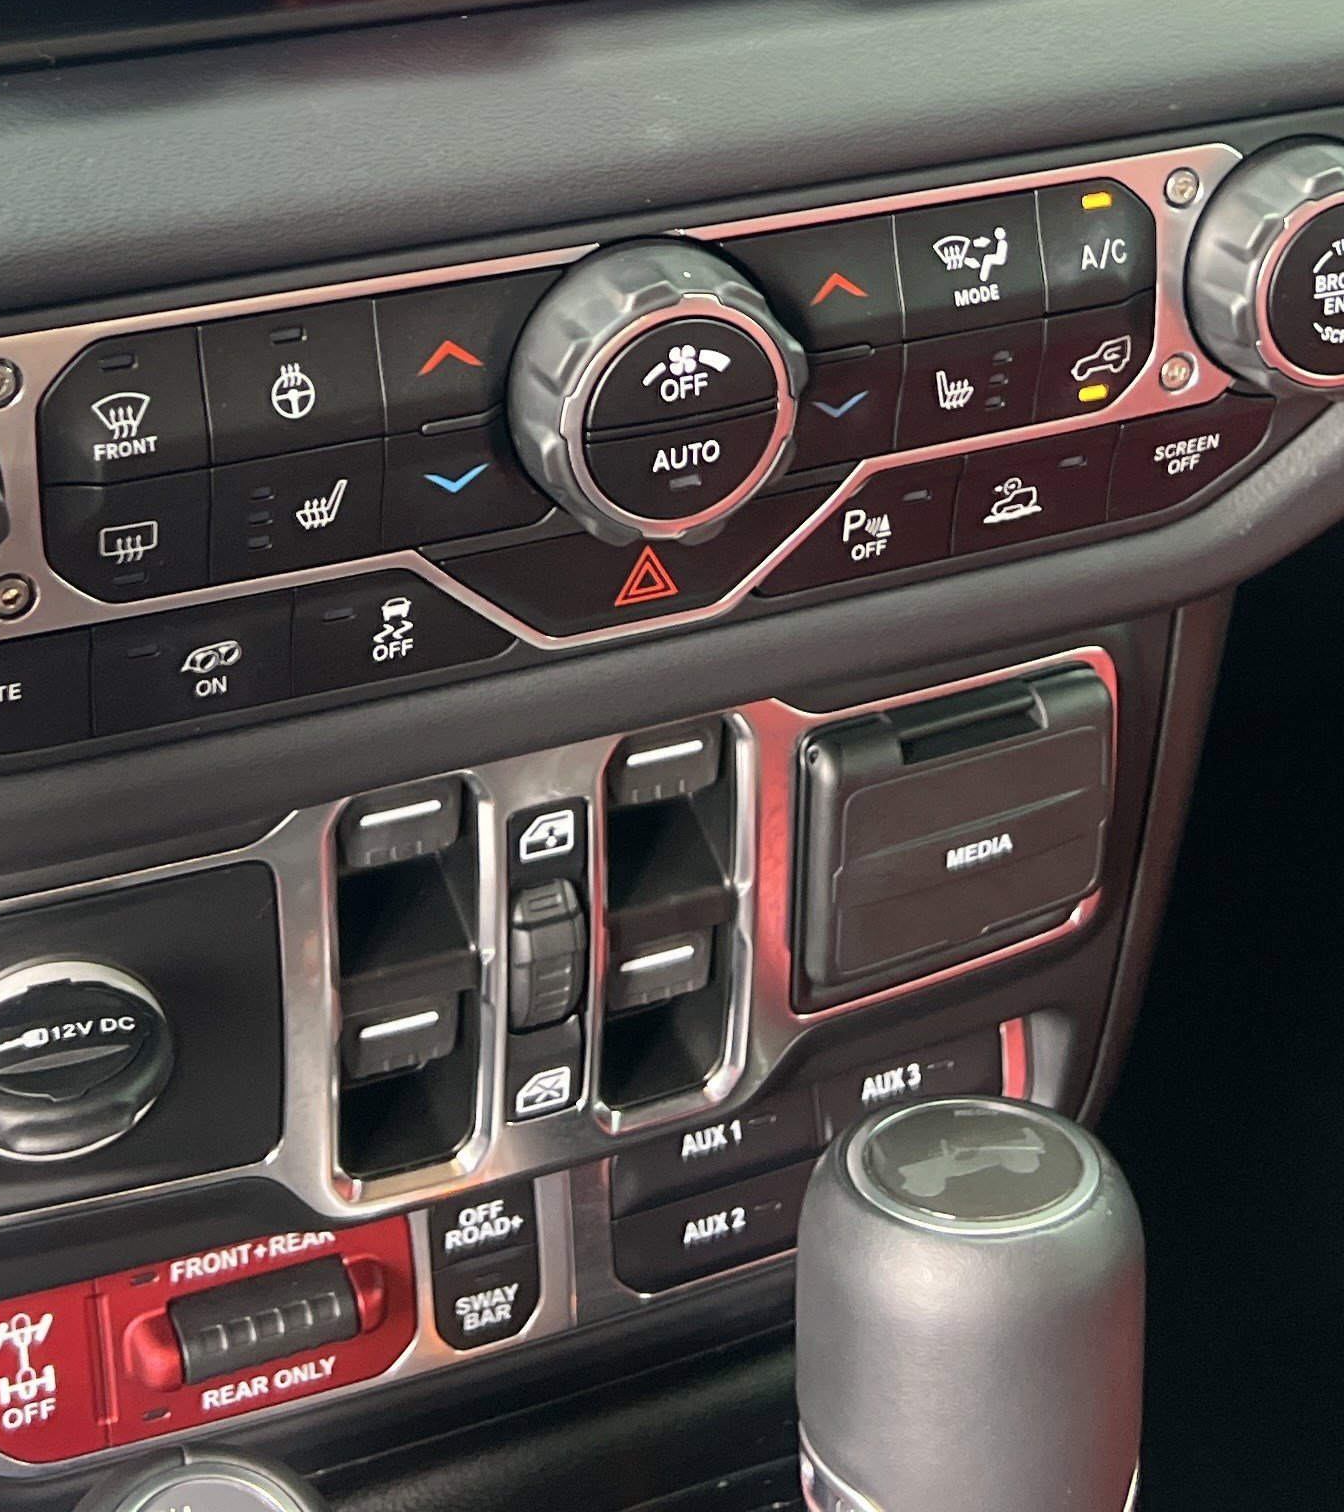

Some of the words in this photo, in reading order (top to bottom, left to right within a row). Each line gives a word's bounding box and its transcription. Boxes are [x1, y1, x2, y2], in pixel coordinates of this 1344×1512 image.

[1081, 237, 1127, 271] A/C
[955, 284, 1000, 307] MODE
[660, 372, 709, 402] OFF
[93, 437, 158, 462] FRONT
[652, 439, 721, 473] AUTO
[1154, 433, 1220, 462] SCREEN
[1167, 452, 1201, 475] OFF
[843, 509, 866, 542] P
[851, 539, 887, 561] OFF
[372, 638, 414, 662] OFF
[195, 676, 228, 697] ON
[946, 833, 1014, 870] MEDIA
[51, 1019, 94, 1040] 12V
[100, 1014, 136, 1034] DC
[861, 1068, 906, 1102] AUX
[907, 1064, 922, 1089] 3
[681, 1128, 726, 1157] AUX
[730, 1122, 743, 1143] 1
[457, 1200, 504, 1228] OFF
[682, 1215, 728, 1244] AUX
[730, 1207, 746, 1229] 2
[443, 1213, 524, 1252] ROAD+
[455, 1284, 519, 1316] SWAY
[462, 1301, 513, 1332] BAR
[201, 1374, 270, 1411] REAR
[272, 1356, 337, 1392] ONLY
[1, 1398, 57, 1432] OFF
